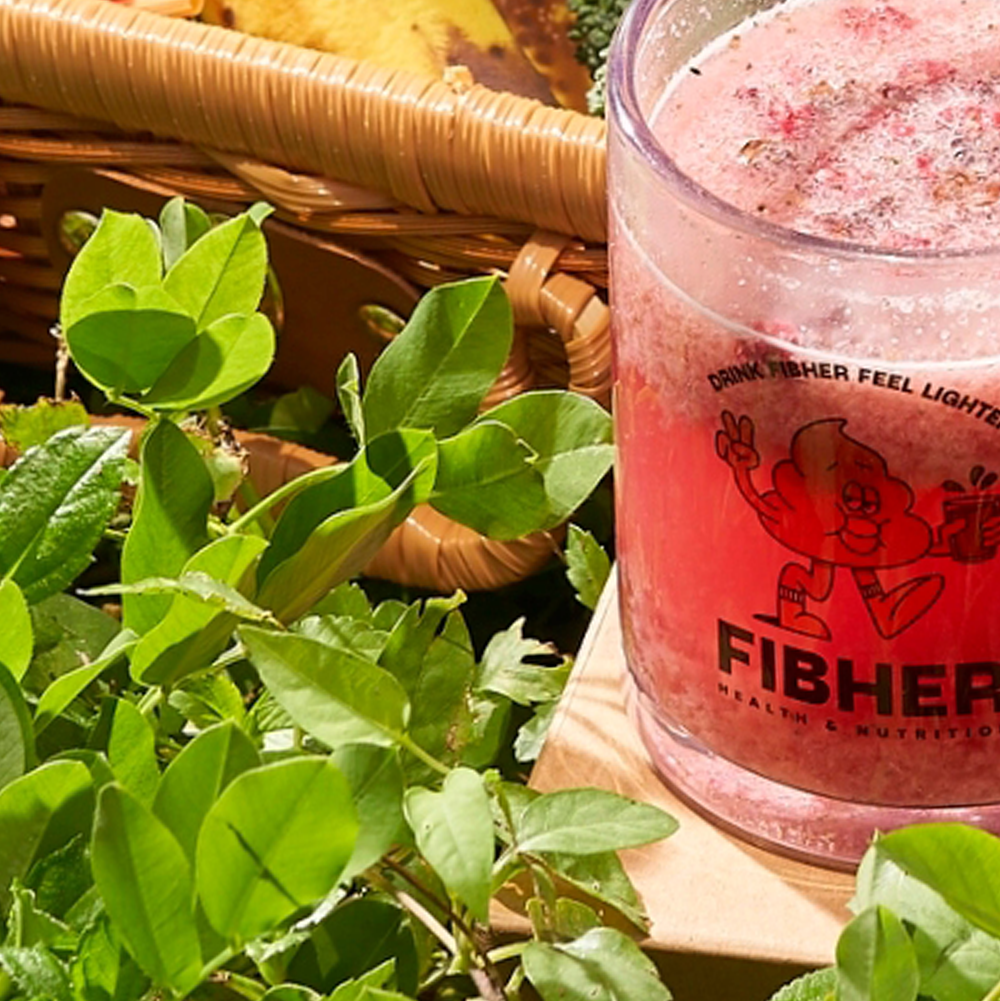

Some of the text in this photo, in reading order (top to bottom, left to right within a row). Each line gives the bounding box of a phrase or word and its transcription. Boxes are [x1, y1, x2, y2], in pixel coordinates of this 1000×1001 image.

[707, 361, 764, 392] DRINK
[768, 361, 849, 382] FIBHER
[858, 368, 914, 394] FEEL
[718, 683, 808, 725] HEALTH
[825, 720, 838, 731] &
